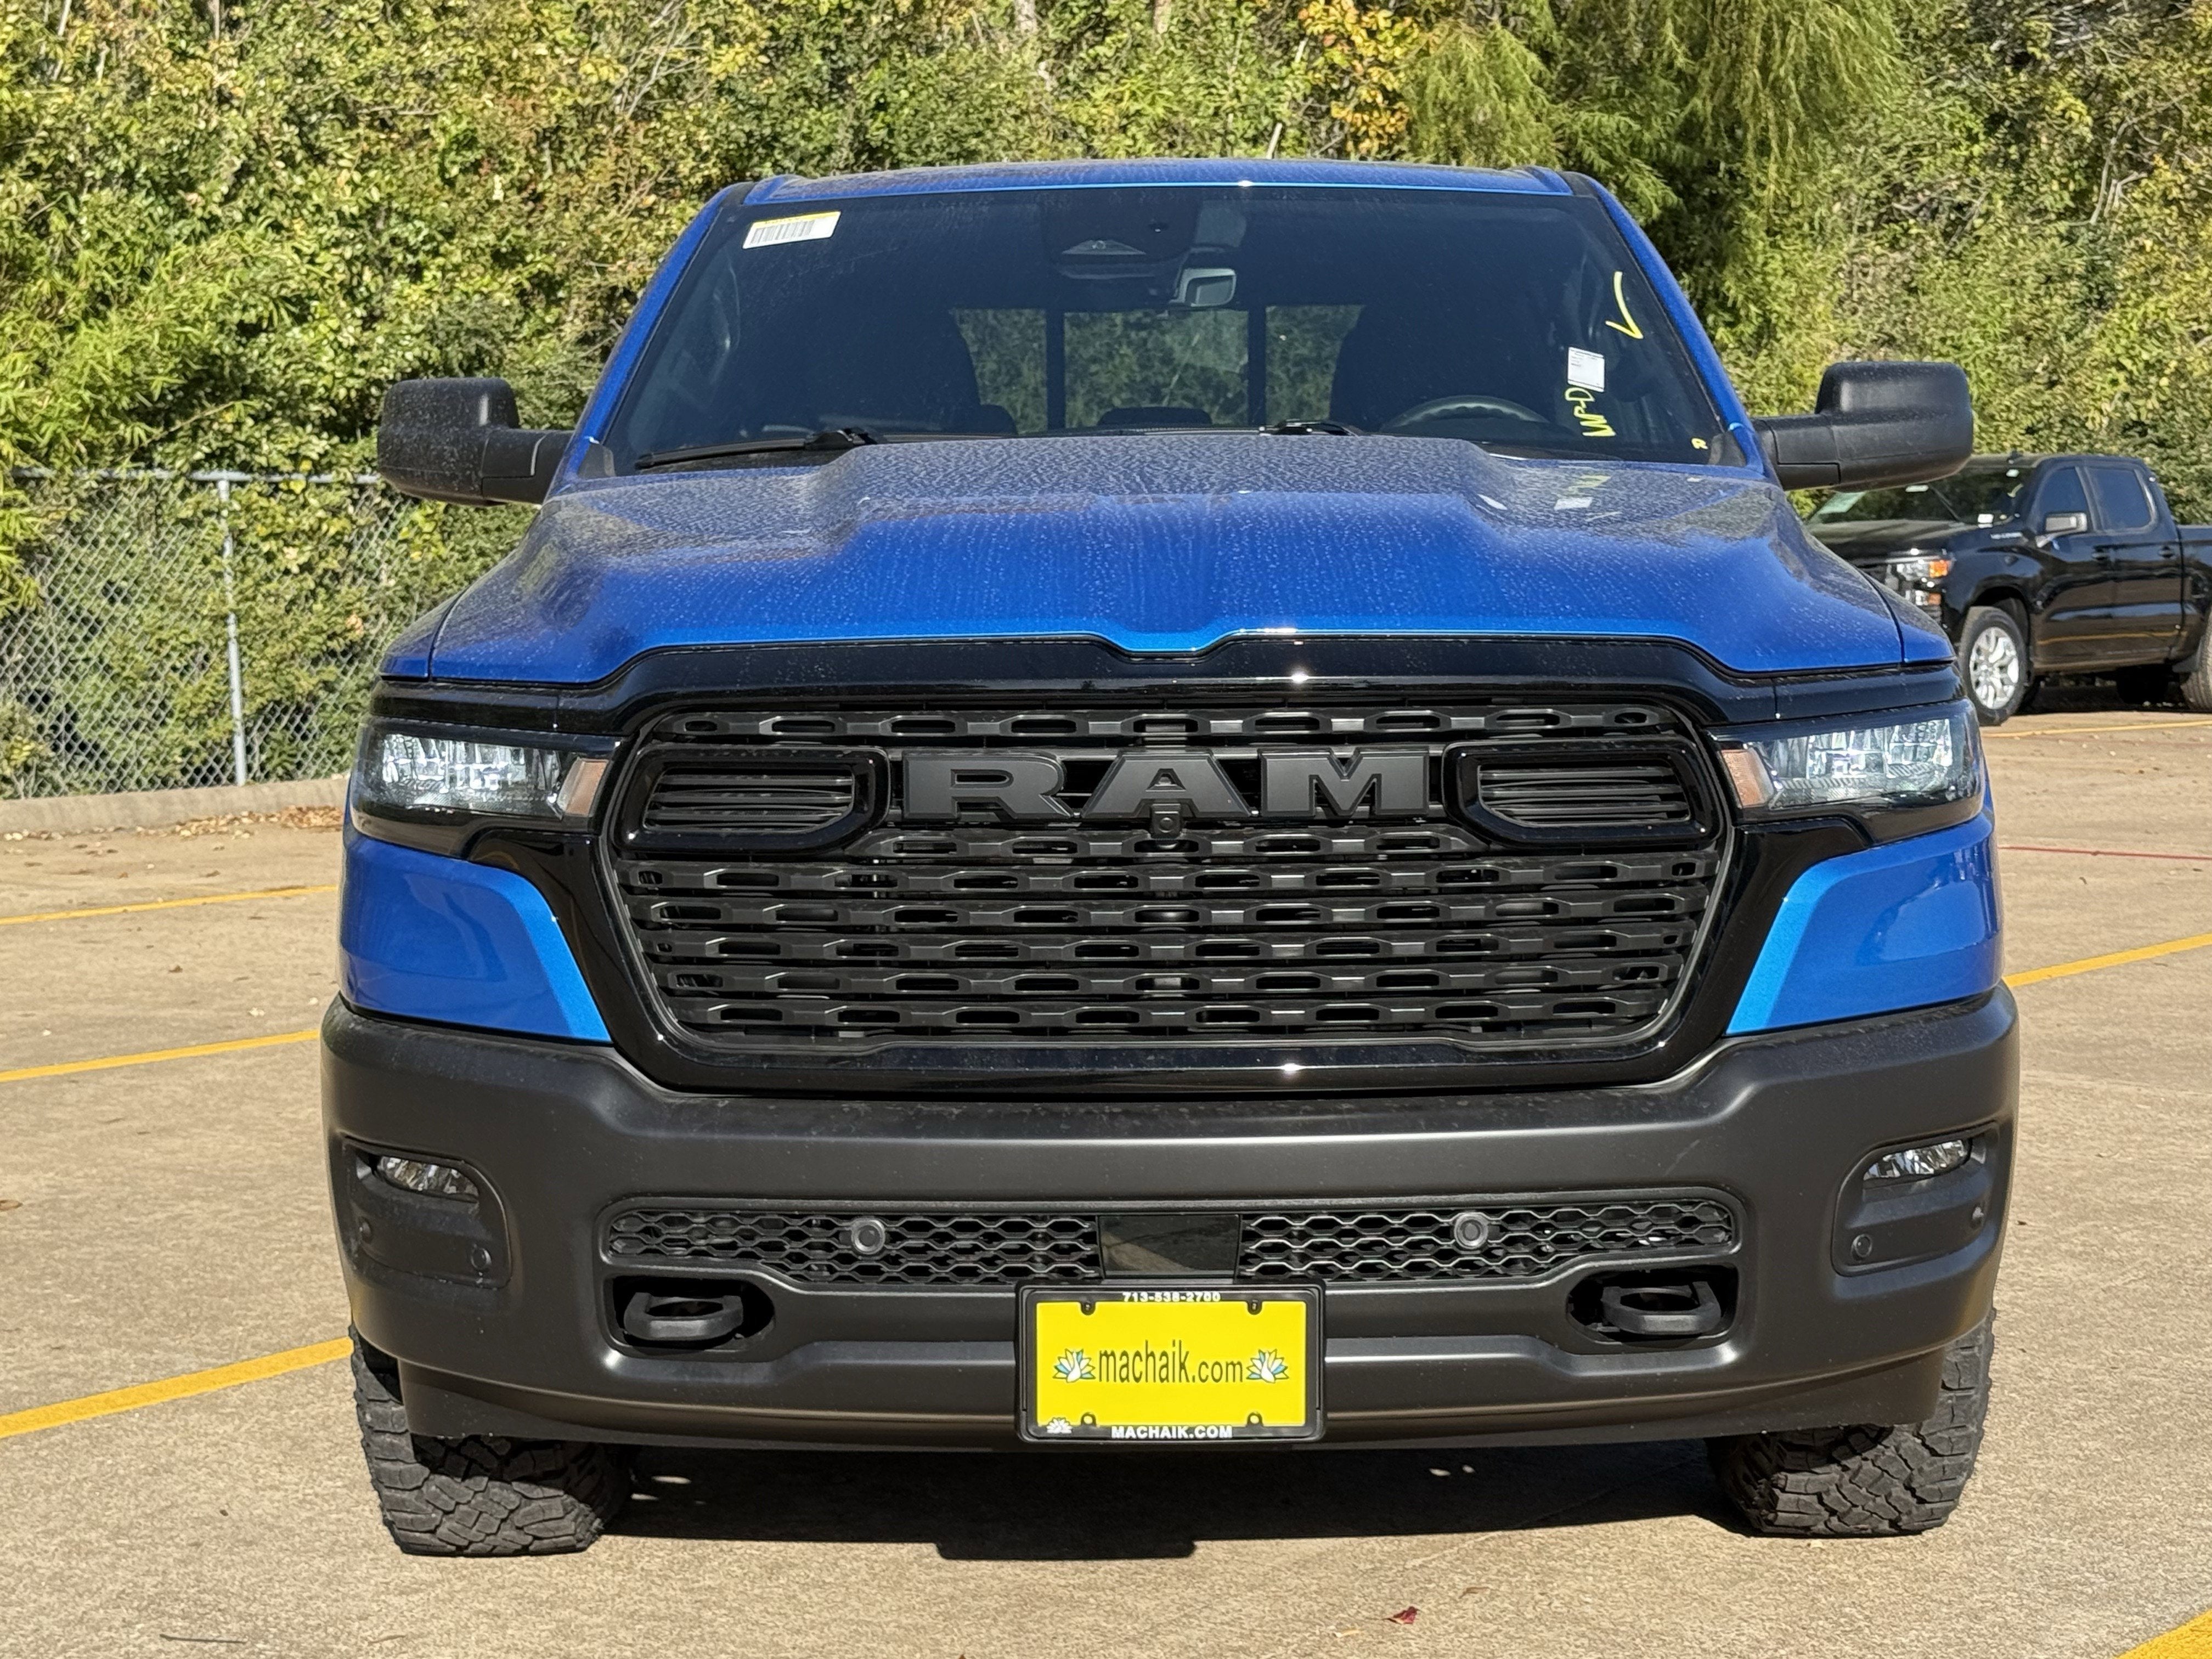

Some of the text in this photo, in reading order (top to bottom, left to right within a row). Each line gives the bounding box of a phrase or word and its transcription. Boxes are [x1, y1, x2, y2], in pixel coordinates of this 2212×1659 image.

[902, 750, 1430, 819] RAM
[1099, 1339, 1243, 1383] machaik.com
[1111, 1425, 1233, 1438] MACHAIK.COM
